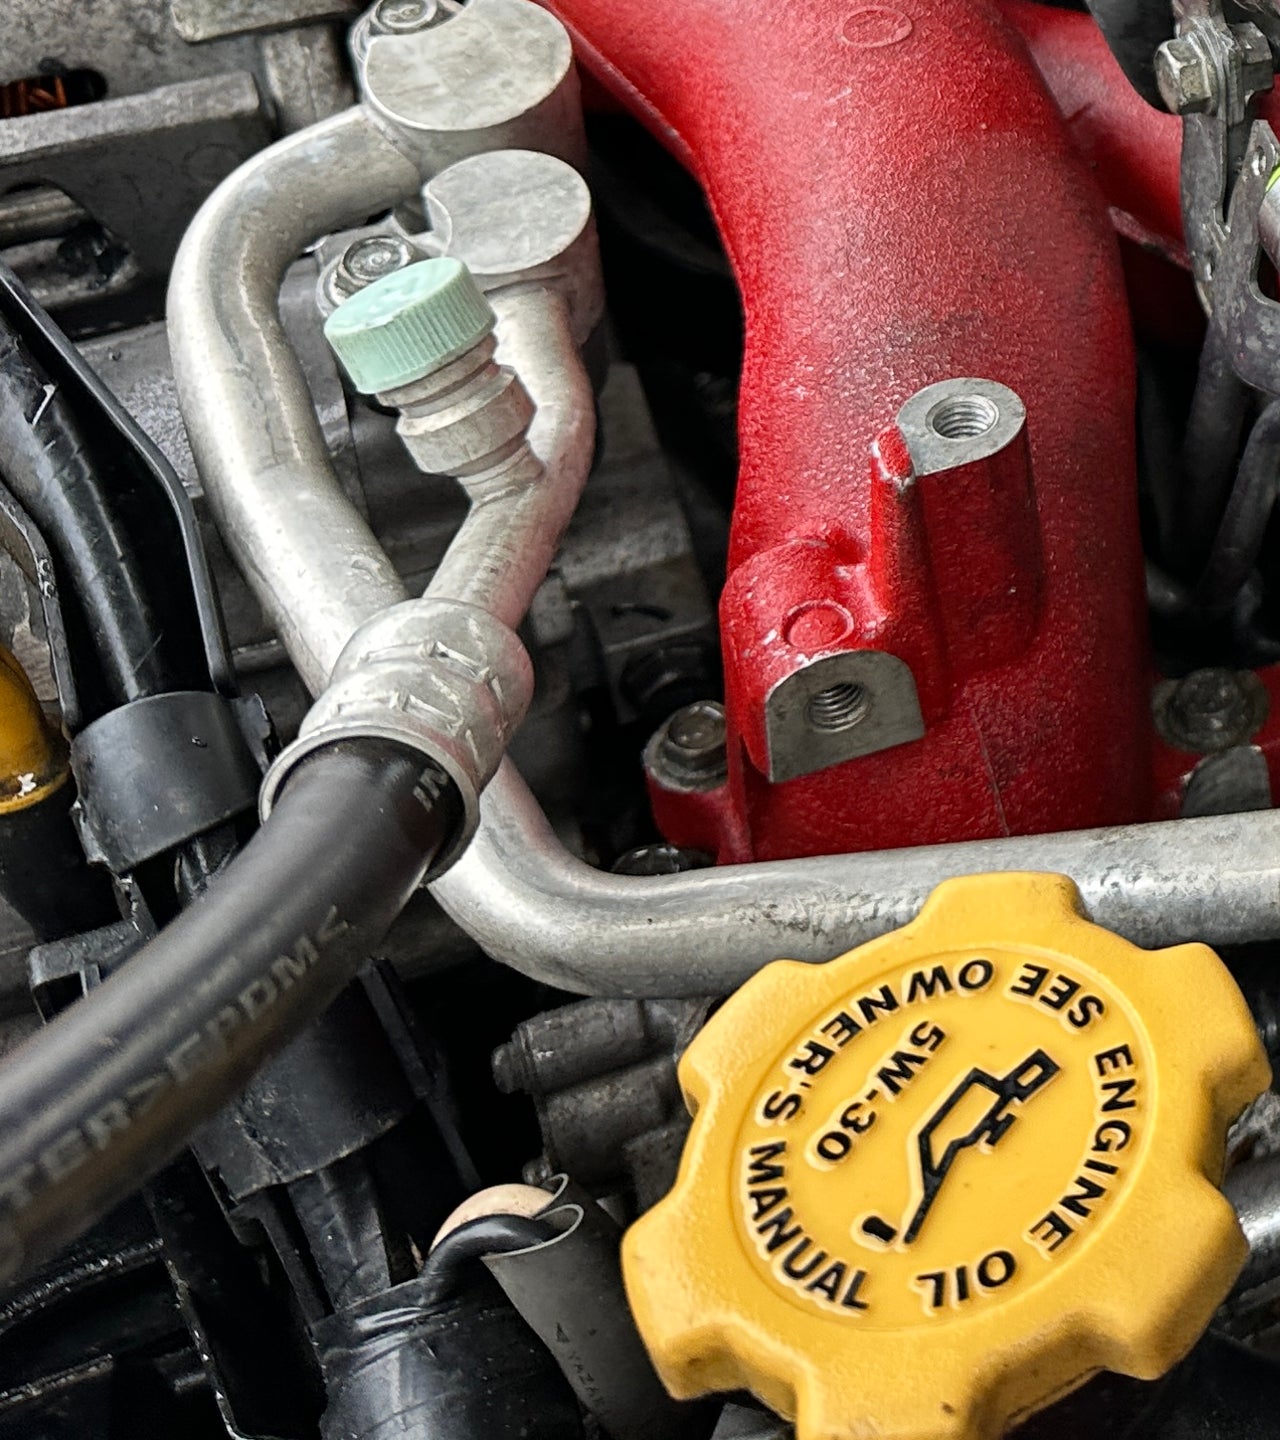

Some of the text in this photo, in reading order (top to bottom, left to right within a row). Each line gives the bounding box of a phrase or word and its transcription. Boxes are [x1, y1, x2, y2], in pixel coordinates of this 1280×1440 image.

[749, 958, 1105, 1311] SEE OWNER'S MANUAL
[816, 1020, 947, 1162] 5W-30
[917, 1043, 1137, 1309] ENGINE OIL
